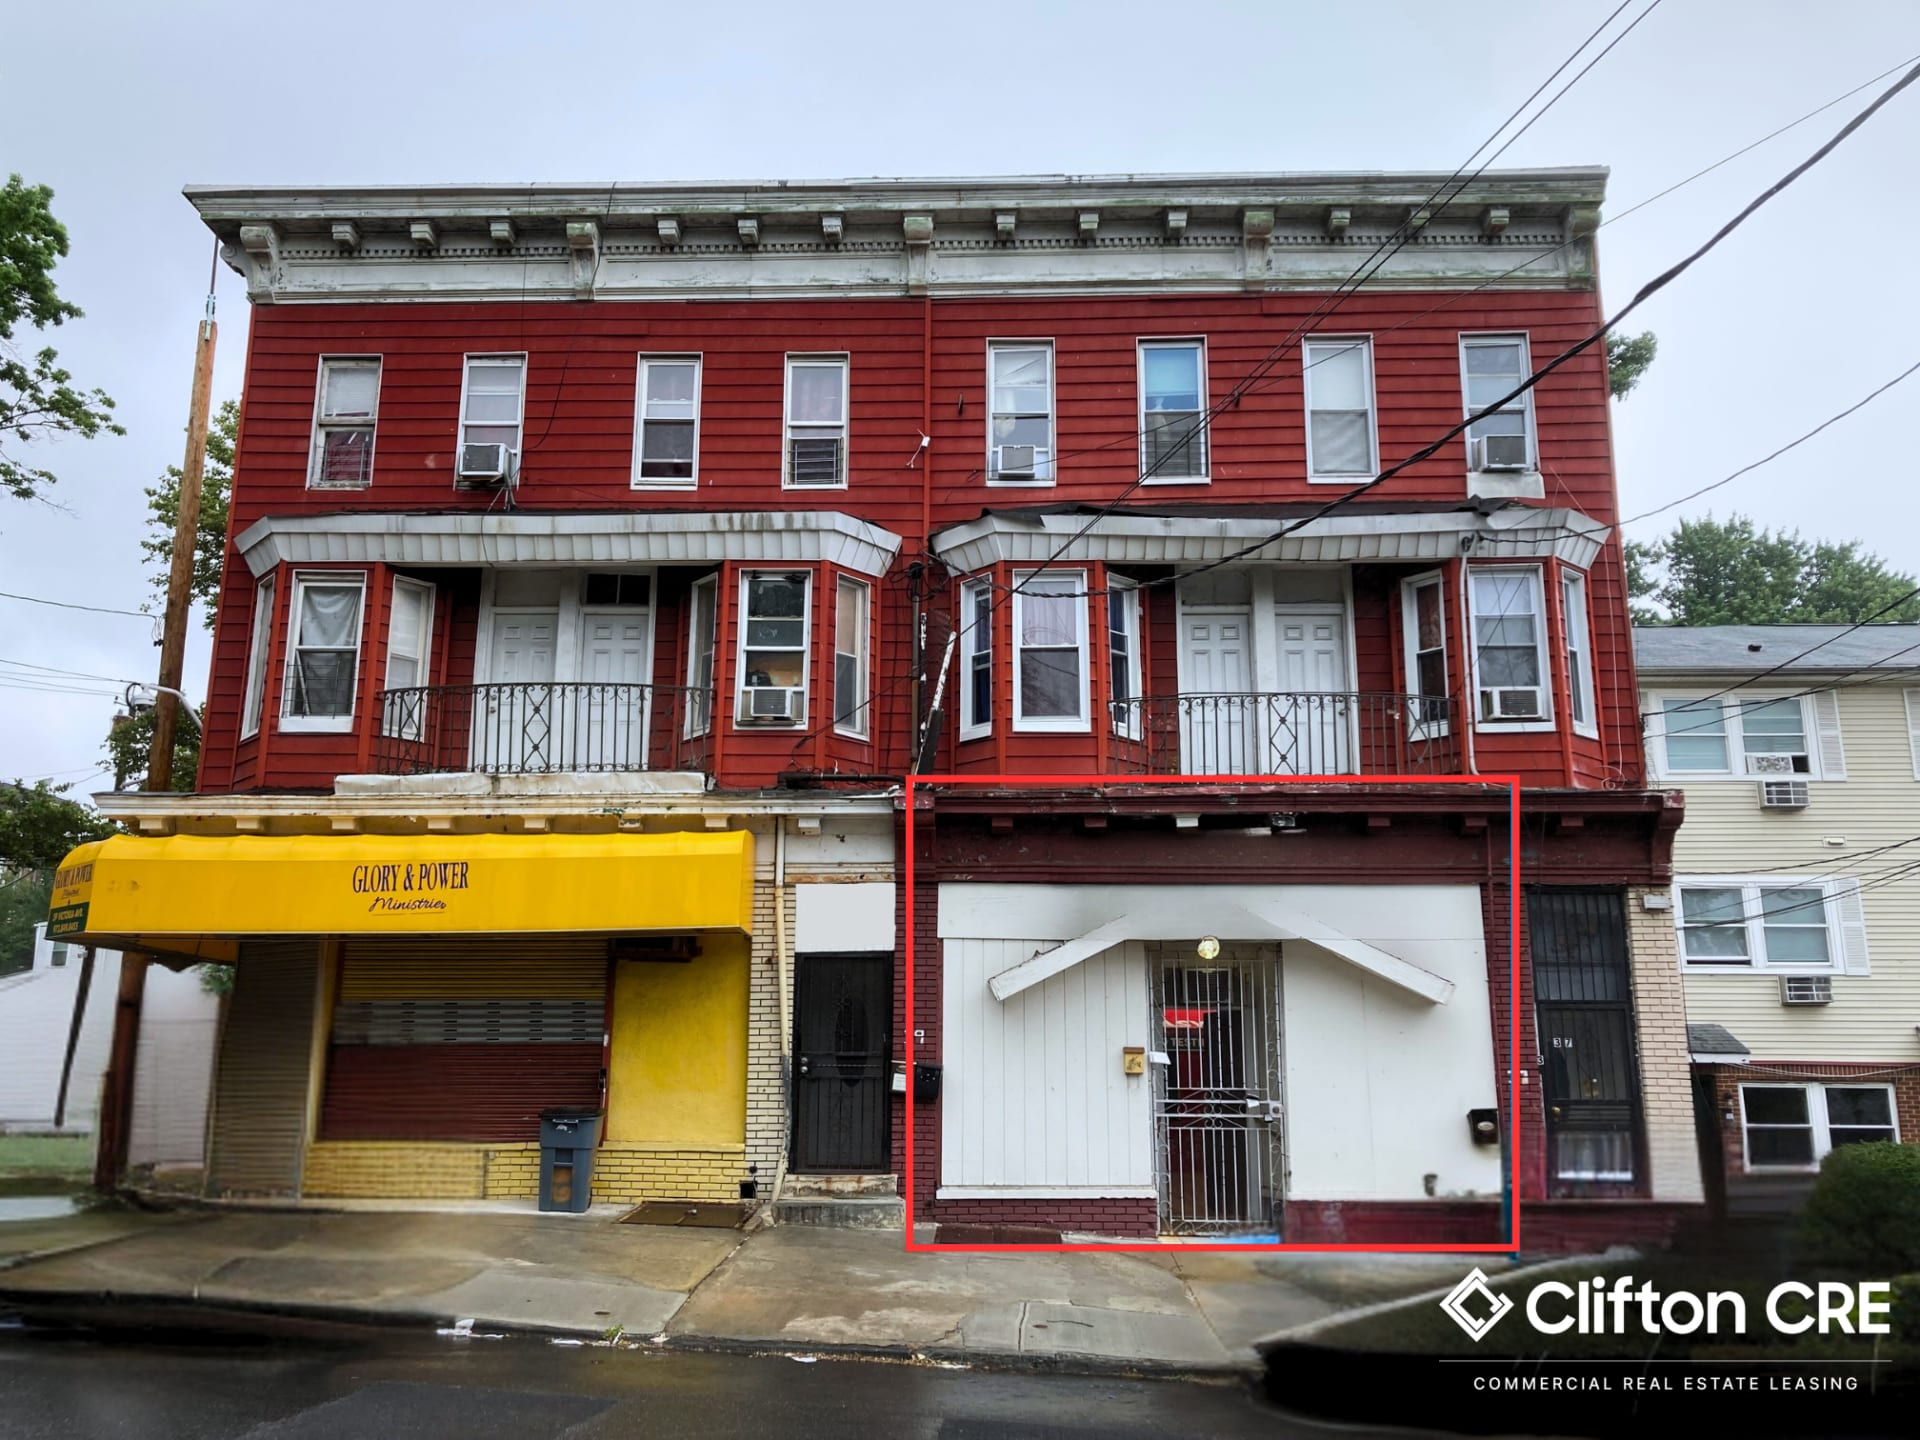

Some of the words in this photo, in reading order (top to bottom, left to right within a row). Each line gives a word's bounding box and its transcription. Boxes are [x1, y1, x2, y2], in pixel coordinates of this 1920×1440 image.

[353, 864, 401, 893] GLORY
[404, 863, 415, 891] &
[418, 862, 469, 890] POWER
[368, 896, 447, 912] Ministries
[1553, 1037, 1573, 1048] 37
